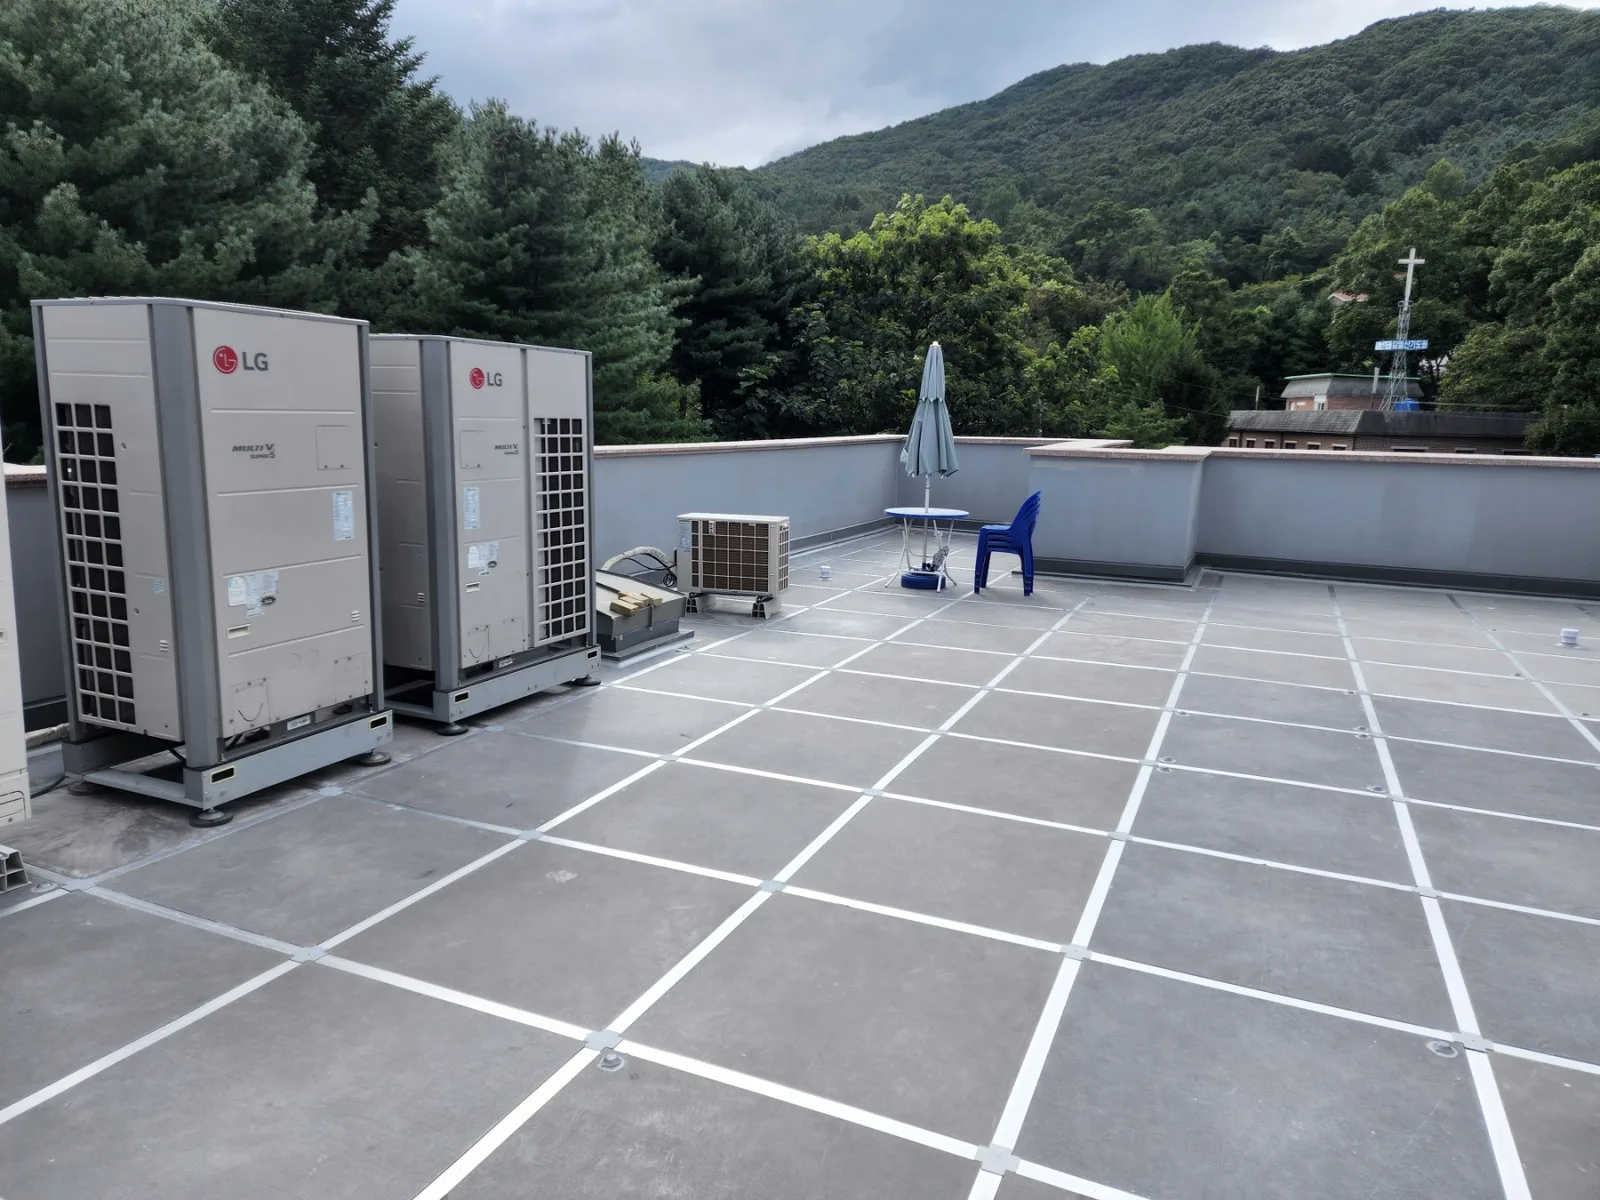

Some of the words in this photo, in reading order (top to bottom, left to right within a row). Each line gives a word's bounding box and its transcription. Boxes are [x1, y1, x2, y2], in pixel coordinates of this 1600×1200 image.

[241, 351, 269, 372] LG
[486, 371, 503, 387] LG
[265, 443, 276, 451] V
